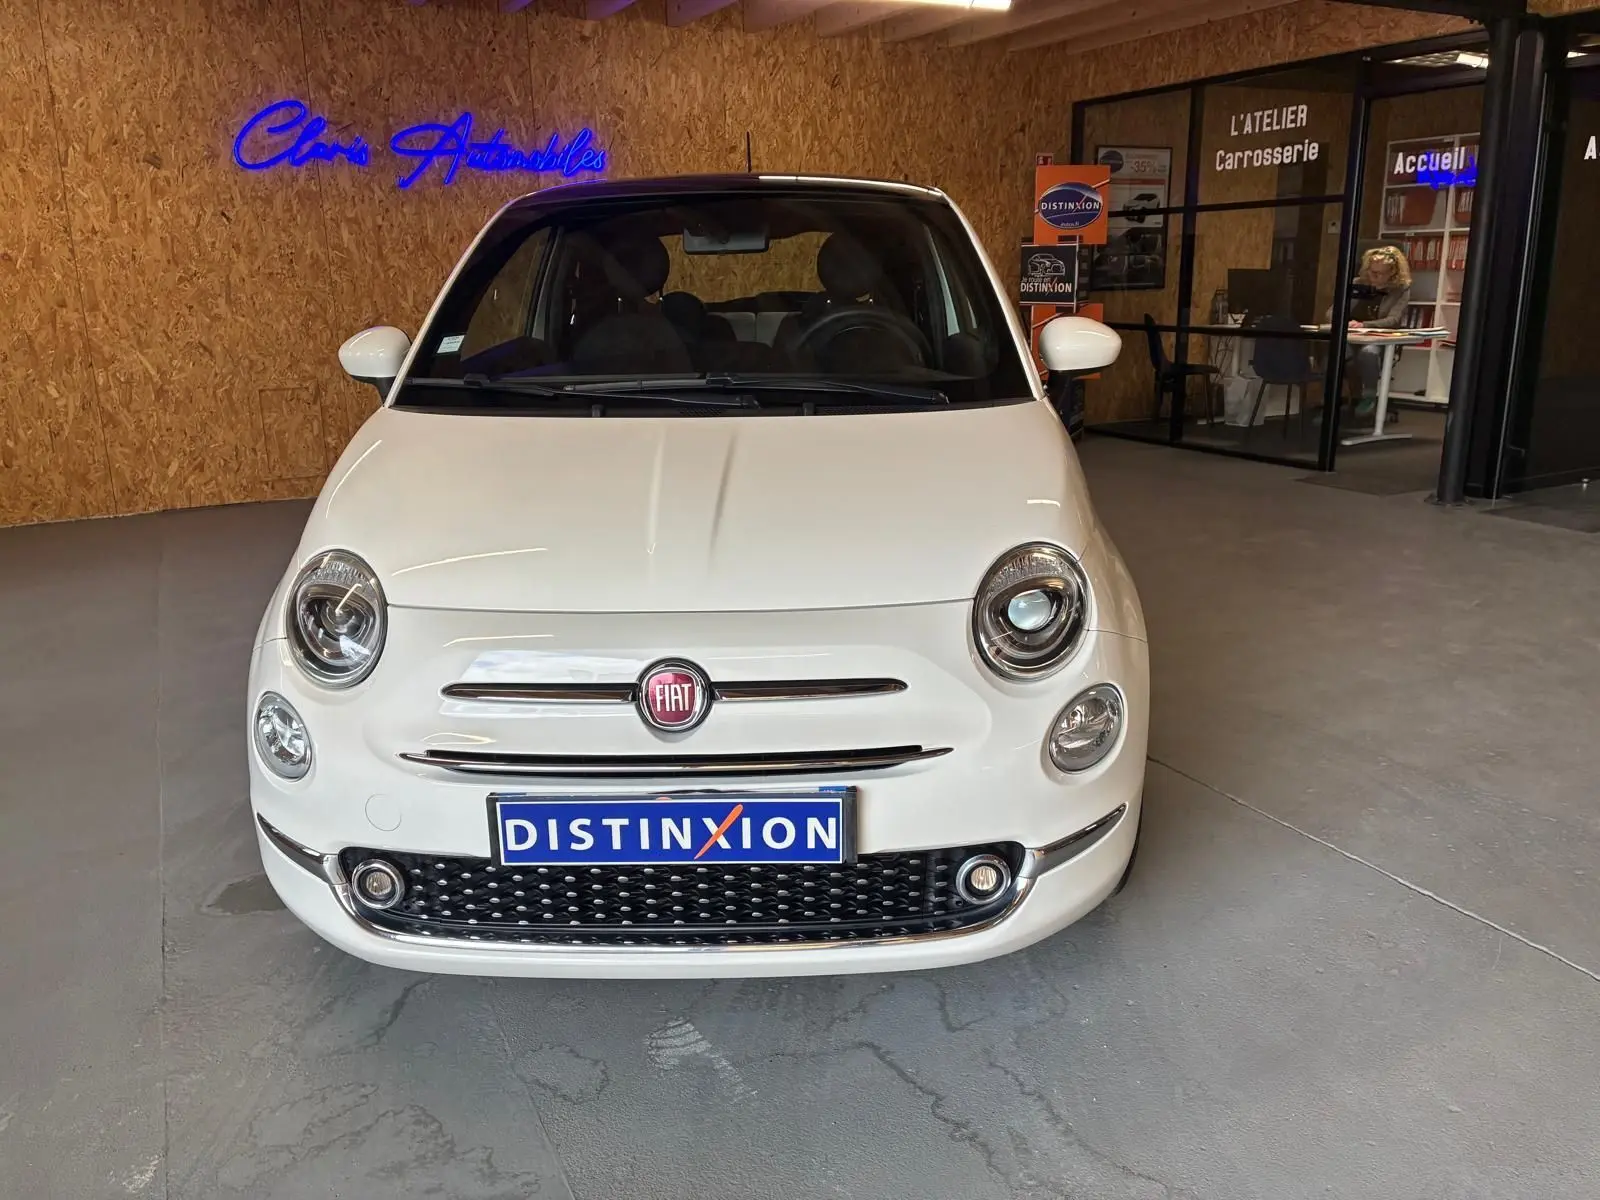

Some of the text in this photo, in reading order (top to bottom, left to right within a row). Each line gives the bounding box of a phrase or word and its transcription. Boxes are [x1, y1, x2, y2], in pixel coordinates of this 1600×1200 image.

[1230, 104, 1308, 137] L'ATELIER
[389, 111, 606, 188] Automobiles
[1215, 139, 1320, 171] Carrosserie
[1393, 146, 1466, 175] Accueil
[1583, 135, 1599, 160] A
[1041, 199, 1100, 212] DISTINXION
[1020, 280, 1072, 294] DISTINXION
[655, 682, 693, 712] FIAT
[504, 805, 837, 859] DISTINXION
